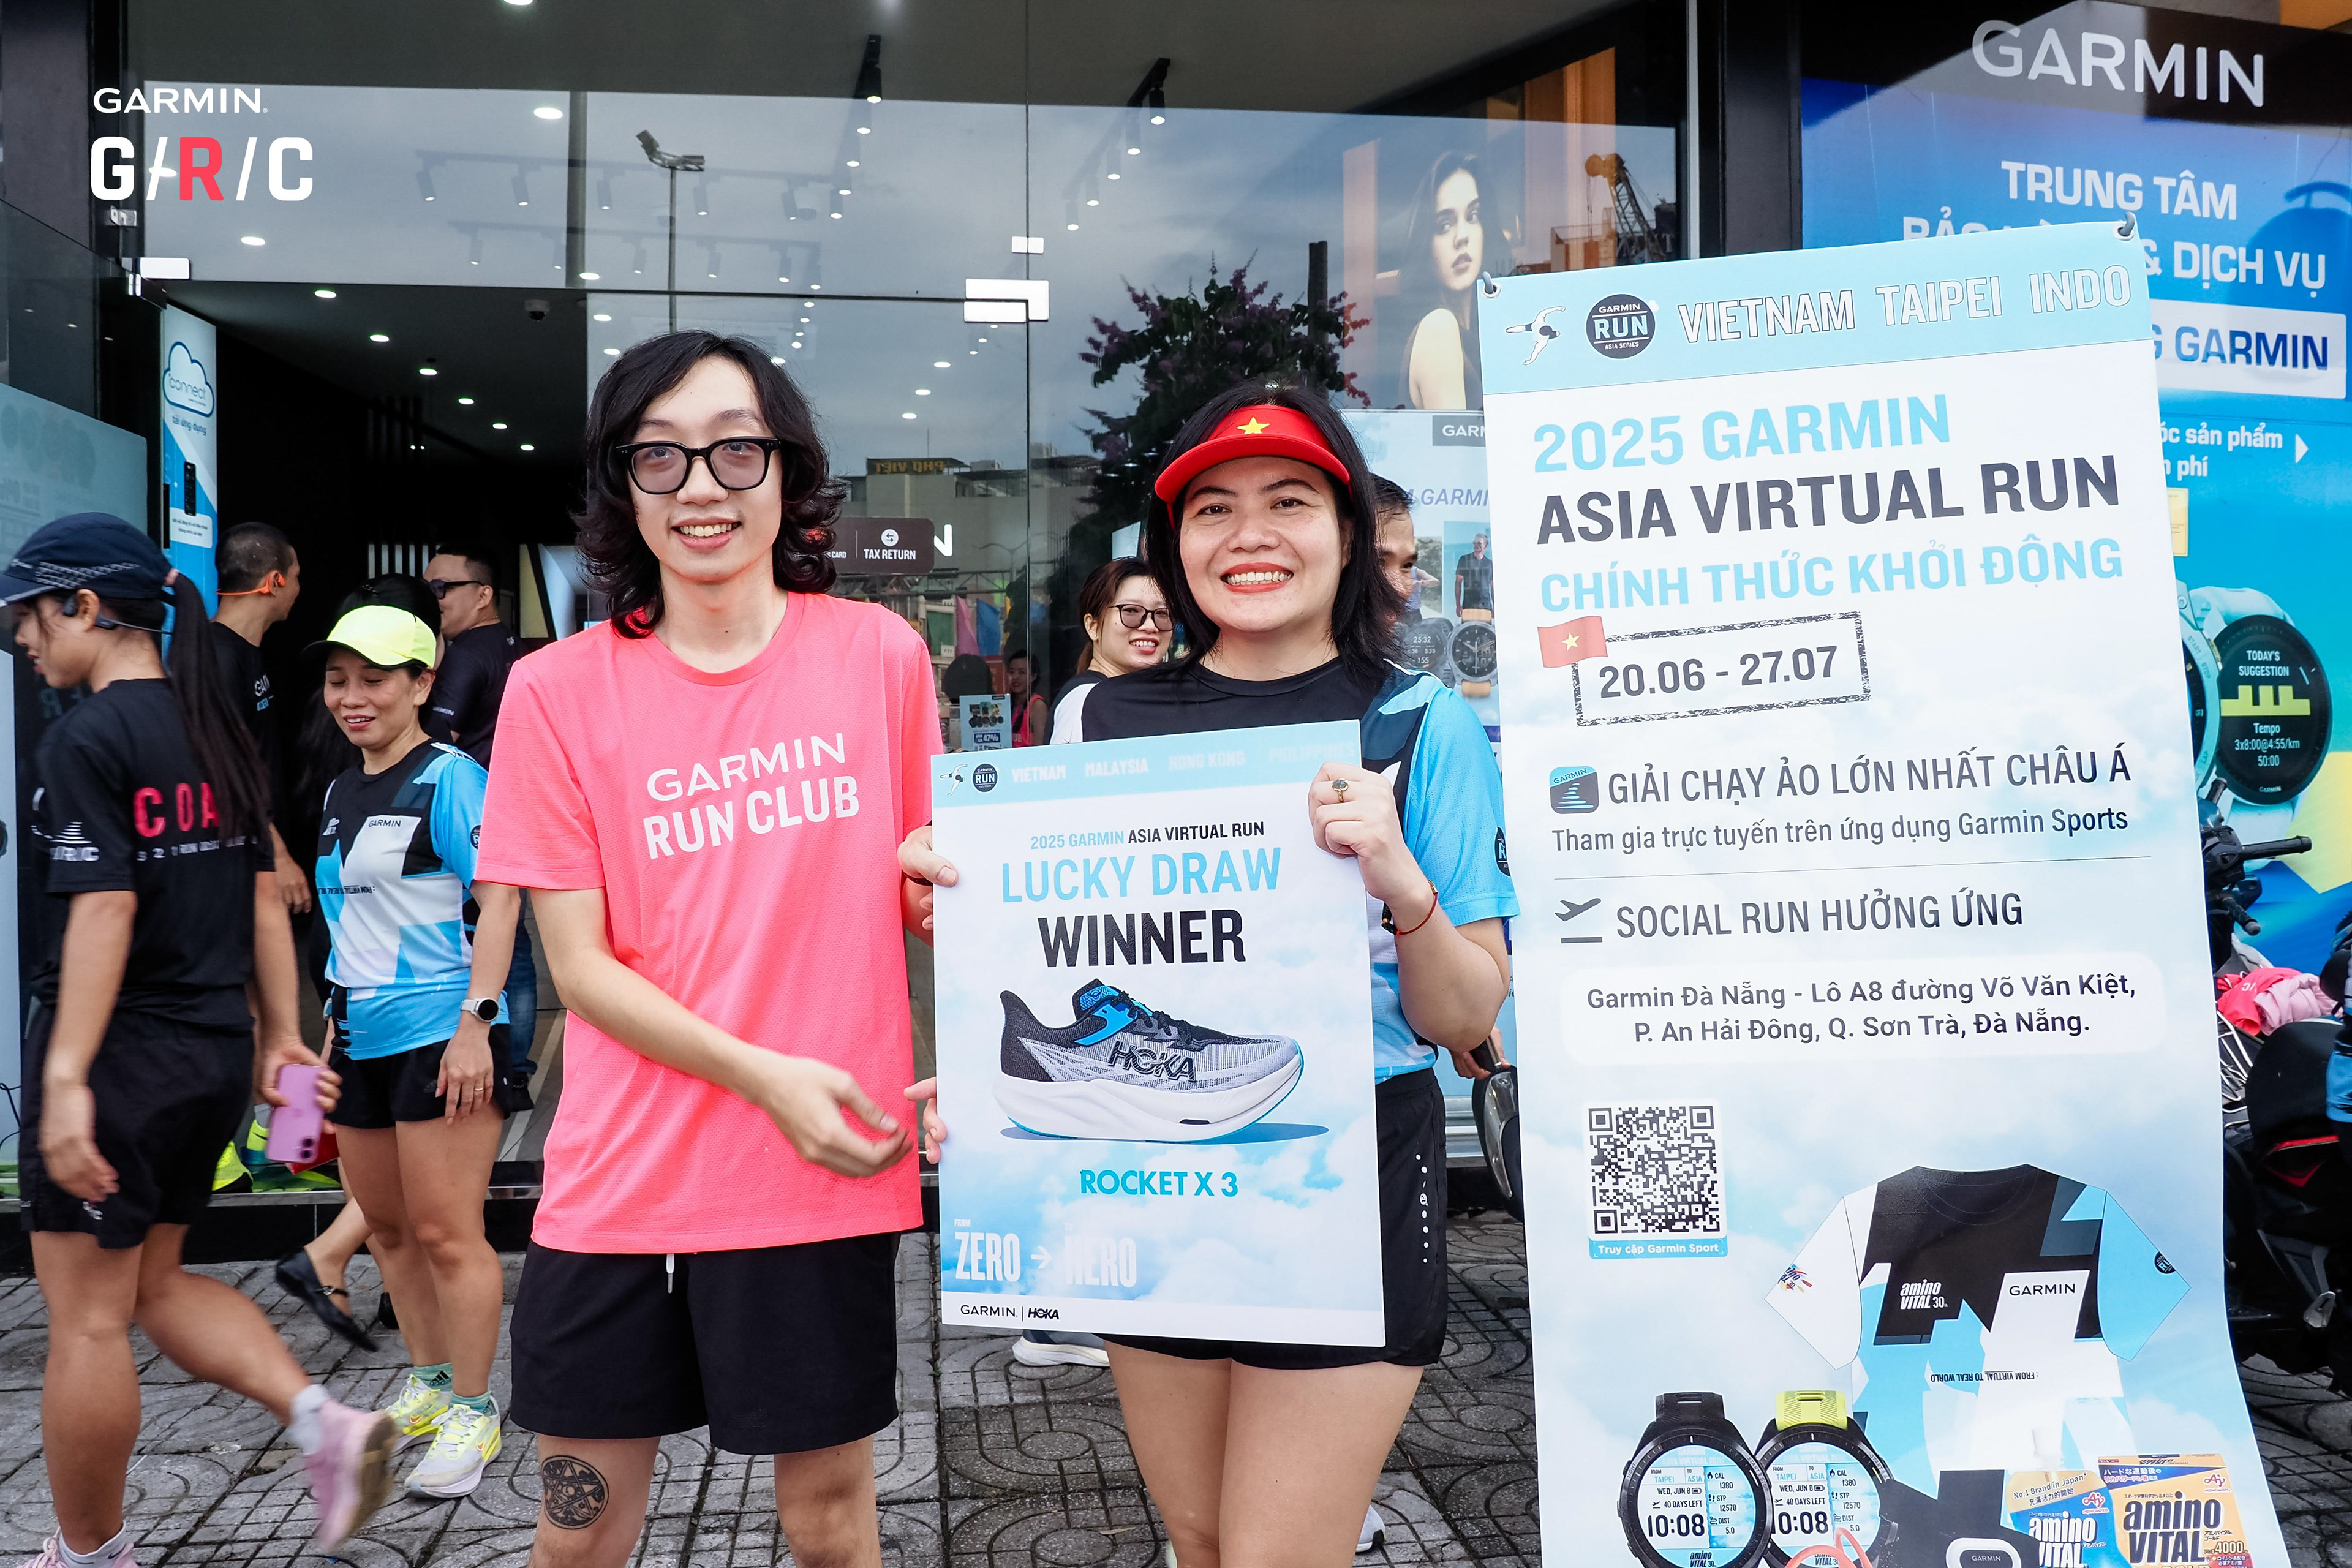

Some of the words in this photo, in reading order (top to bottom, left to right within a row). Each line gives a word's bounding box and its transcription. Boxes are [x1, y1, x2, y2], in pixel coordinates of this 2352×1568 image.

[1972, 20, 2265, 107] GARMIN
[2001, 161, 2143, 211] TRUNG
[2153, 171, 2237, 221] TÂM
[2174, 242, 2264, 289] DỊCH
[2276, 253, 2327, 298] VỤ
[1598, 303, 1641, 314] GARMIN
[1678, 290, 1856, 343] VIETNAM
[1875, 276, 2003, 326] TAIPEI
[2029, 264, 2132, 314] INDO
[1593, 315, 1649, 340] RUN
[2176, 326, 2329, 371] GARMIN
[1442, 424, 1486, 437] GAR
[1534, 415, 1684, 473] 2025
[1702, 394, 1950, 461] GARMIN
[2185, 422, 2222, 445] sản
[2228, 422, 2283, 451] phẩm
[2177, 454, 2209, 481] phí
[1420, 488, 1490, 506] GARMI
[1537, 488, 1677, 545] ASIA
[1691, 467, 1964, 534] VIRTUAL
[1980, 455, 2120, 514] RUN
[864, 549, 881, 559] TAX
[882, 549, 916, 560] RETURN
[1540, 560, 1689, 613] CHÍNH
[1702, 549, 1835, 603] THỨC
[1849, 540, 1965, 594] KHỞI
[1980, 533, 2124, 589] ĐỘNG
[2247, 650, 2280, 662] TODAY'S
[1599, 658, 1706, 699] 20.06
[1741, 645, 1838, 688] 27.07
[2239, 666, 2290, 677] SUGGESTION
[2253, 723, 2280, 736] Tempo
[2234, 739, 2301, 752] 3x8:00@4:55/km
[647, 733, 845, 801] GARMIN
[1011, 764, 1066, 783] VIETNAM
[1085, 758, 1149, 777] MALAYSIA
[1208, 751, 1245, 769] KONG
[1608, 763, 1670, 804] GIẢI
[1681, 767, 1766, 806] CHẠY
[1777, 756, 1819, 797] ẢO
[1831, 754, 1895, 794] LỚN
[1907, 746, 1995, 791] NHẤT
[2007, 745, 2097, 786] CHÂU
[2109, 742, 2132, 782] Á
[2258, 755, 2280, 767] 50:00
[975, 773, 995, 783] RUN
[1553, 768, 1589, 785] GARMIN
[133, 782, 220, 837] COA
[368, 819, 401, 827] GARMIN
[643, 801, 734, 860] RUN
[746, 775, 859, 834] CLUB
[1031, 835, 1065, 850] 2025
[1068, 831, 1125, 847] GARMIN
[1128, 827, 1161, 844] ASIA
[1164, 824, 1229, 842] VIRTUAL
[1231, 821, 1265, 838] RUN
[1552, 828, 1614, 852] Tham
[1622, 826, 1655, 855] gia
[1662, 826, 1708, 853] trực
[1713, 818, 1777, 851] tuyến
[1785, 819, 1833, 843] trên
[1840, 816, 1884, 845] ứng
[1891, 815, 1950, 843] dụng
[1959, 809, 2045, 835] Garmin
[2052, 808, 2128, 837] Sports
[1001, 855, 1134, 903] LUCKY
[1152, 847, 1281, 895] DRAW
[1617, 904, 1732, 938] SOCIAL
[1741, 900, 1809, 935] RUN
[1821, 888, 1940, 931] HƯỞNG
[1951, 886, 2023, 927] ỨNG
[1038, 909, 1246, 968] WINNER
[1587, 987, 1673, 1009] Garmin
[1681, 985, 1713, 1007] Đà
[1721, 981, 1785, 1009] Nẵng
[1811, 982, 1841, 1003] Lô
[1849, 981, 1883, 1002] A8
[1891, 978, 1973, 1004] đường
[1980, 976, 2015, 998] Võ
[2021, 975, 2070, 997] Văn
[2079, 973, 2136, 999] Kiệt,
[1635, 1022, 1653, 1042] P.
[1661, 1021, 1693, 1042] An
[1700, 1017, 1741, 1041] Hải
[1747, 1019, 1820, 1044] Đông,
[1828, 1017, 1854, 1039] Q.
[1863, 1017, 1911, 1037] Sơn
[1917, 1013, 1966, 1039] Trà,
[1973, 1012, 2008, 1034] Đà
[2016, 1008, 2090, 1036] Nẵng.
[1108, 1041, 1196, 1082] HOKA
[1080, 1169, 1188, 1196] ROCKET
[1194, 1172, 1214, 1196] X
[1221, 1172, 1238, 1197] 3
[954, 1219, 971, 1227] FROM
[955, 1232, 1020, 1282] ZERO
[1064, 1235, 1137, 1287] HERO
[1598, 1244, 1622, 1256] Truy
[1624, 1243, 1645, 1255] cập
[1647, 1243, 1686, 1254] Garmin
[1688, 1242, 1720, 1256] Sport
[1899, 1278, 1942, 1297] amino
[2008, 1283, 2076, 1297] GARMIN
[960, 1305, 1016, 1317] GARMIN
[1028, 1308, 1060, 1320] HOKA
[1900, 1295, 1931, 1310] VITAL
[1931, 1374, 1955, 1382] WORLD
[1956, 1373, 1973, 1382] REAL
[1975, 1373, 1984, 1381] TO
[1985, 1372, 2013, 1381] VIRTUAL
[2015, 1371, 2035, 1380] FROM
[2014, 1489, 2029, 1499] No.1
[2030, 1484, 2051, 1495] Brand
[2124, 1491, 2222, 1531] amino
[1648, 1513, 1705, 1537] 10:08
[2029, 1511, 2097, 1544] amino
[2128, 1531, 2206, 1564] VITAL
[2215, 1541, 2244, 1555] 4000
